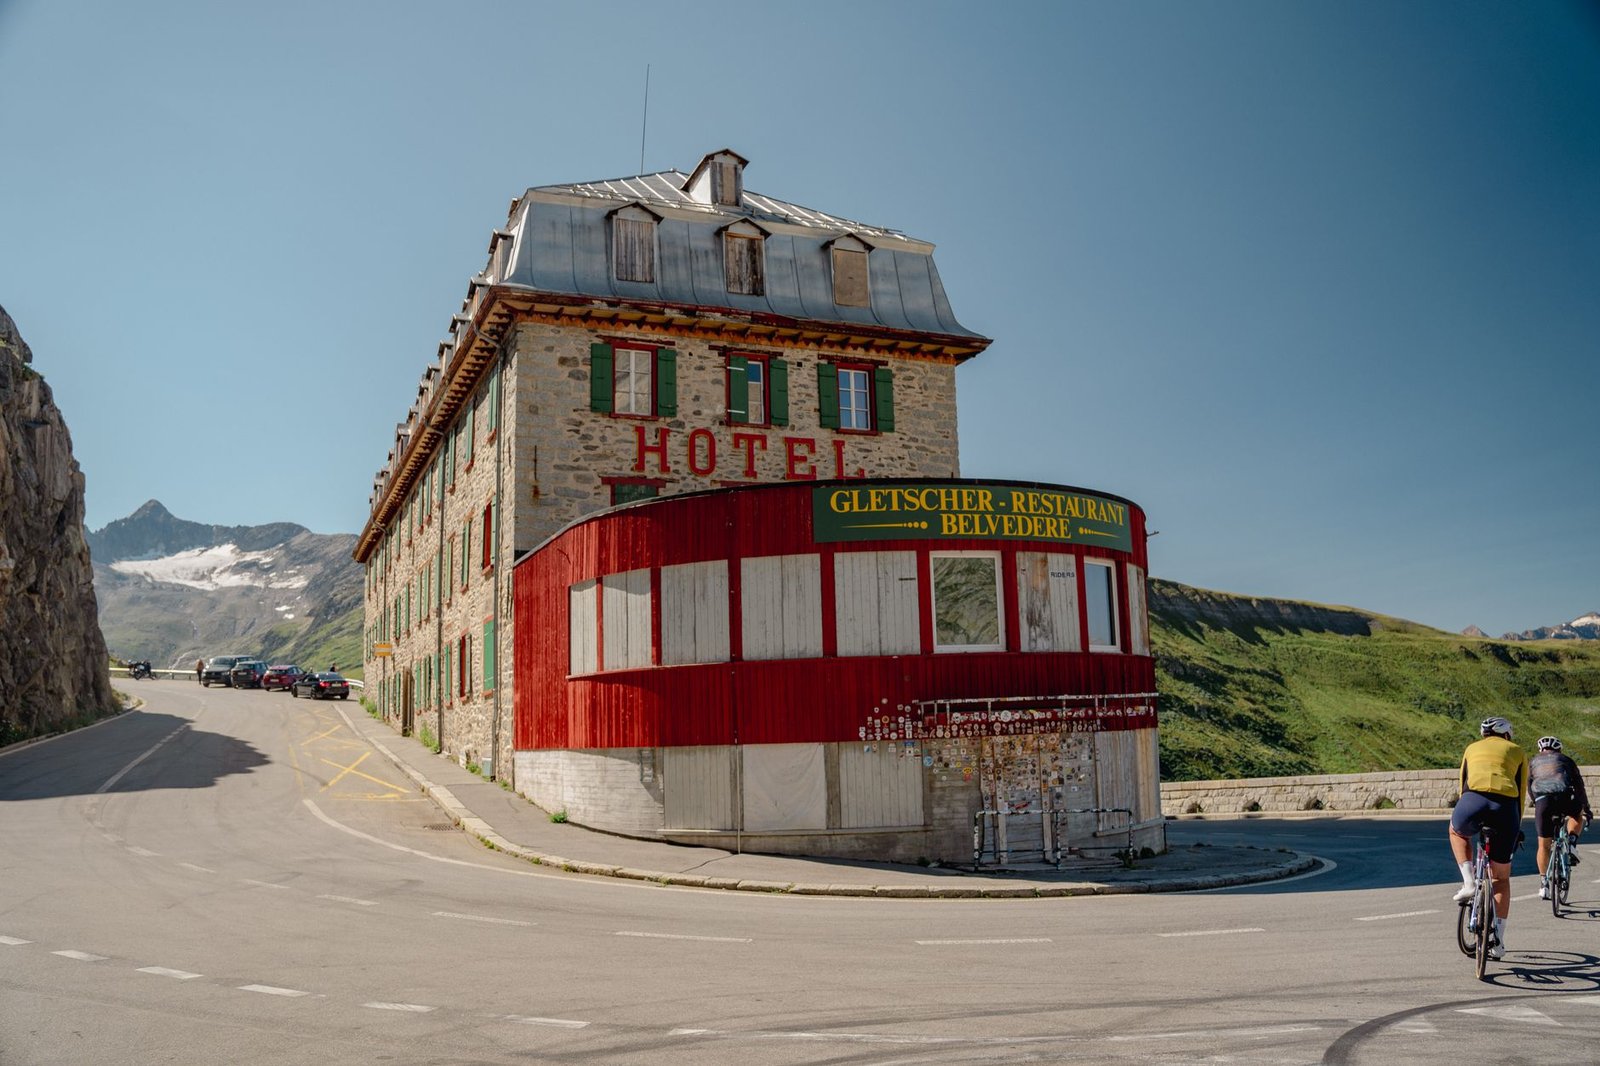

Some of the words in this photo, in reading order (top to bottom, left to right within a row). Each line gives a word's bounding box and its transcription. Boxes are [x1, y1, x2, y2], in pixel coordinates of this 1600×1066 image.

[634, 425, 866, 481] HOTEL
[830, 488, 995, 513] GLETSCHER
[1010, 491, 1125, 526] RESTAURANT
[940, 513, 1072, 539] BELVEDERE
